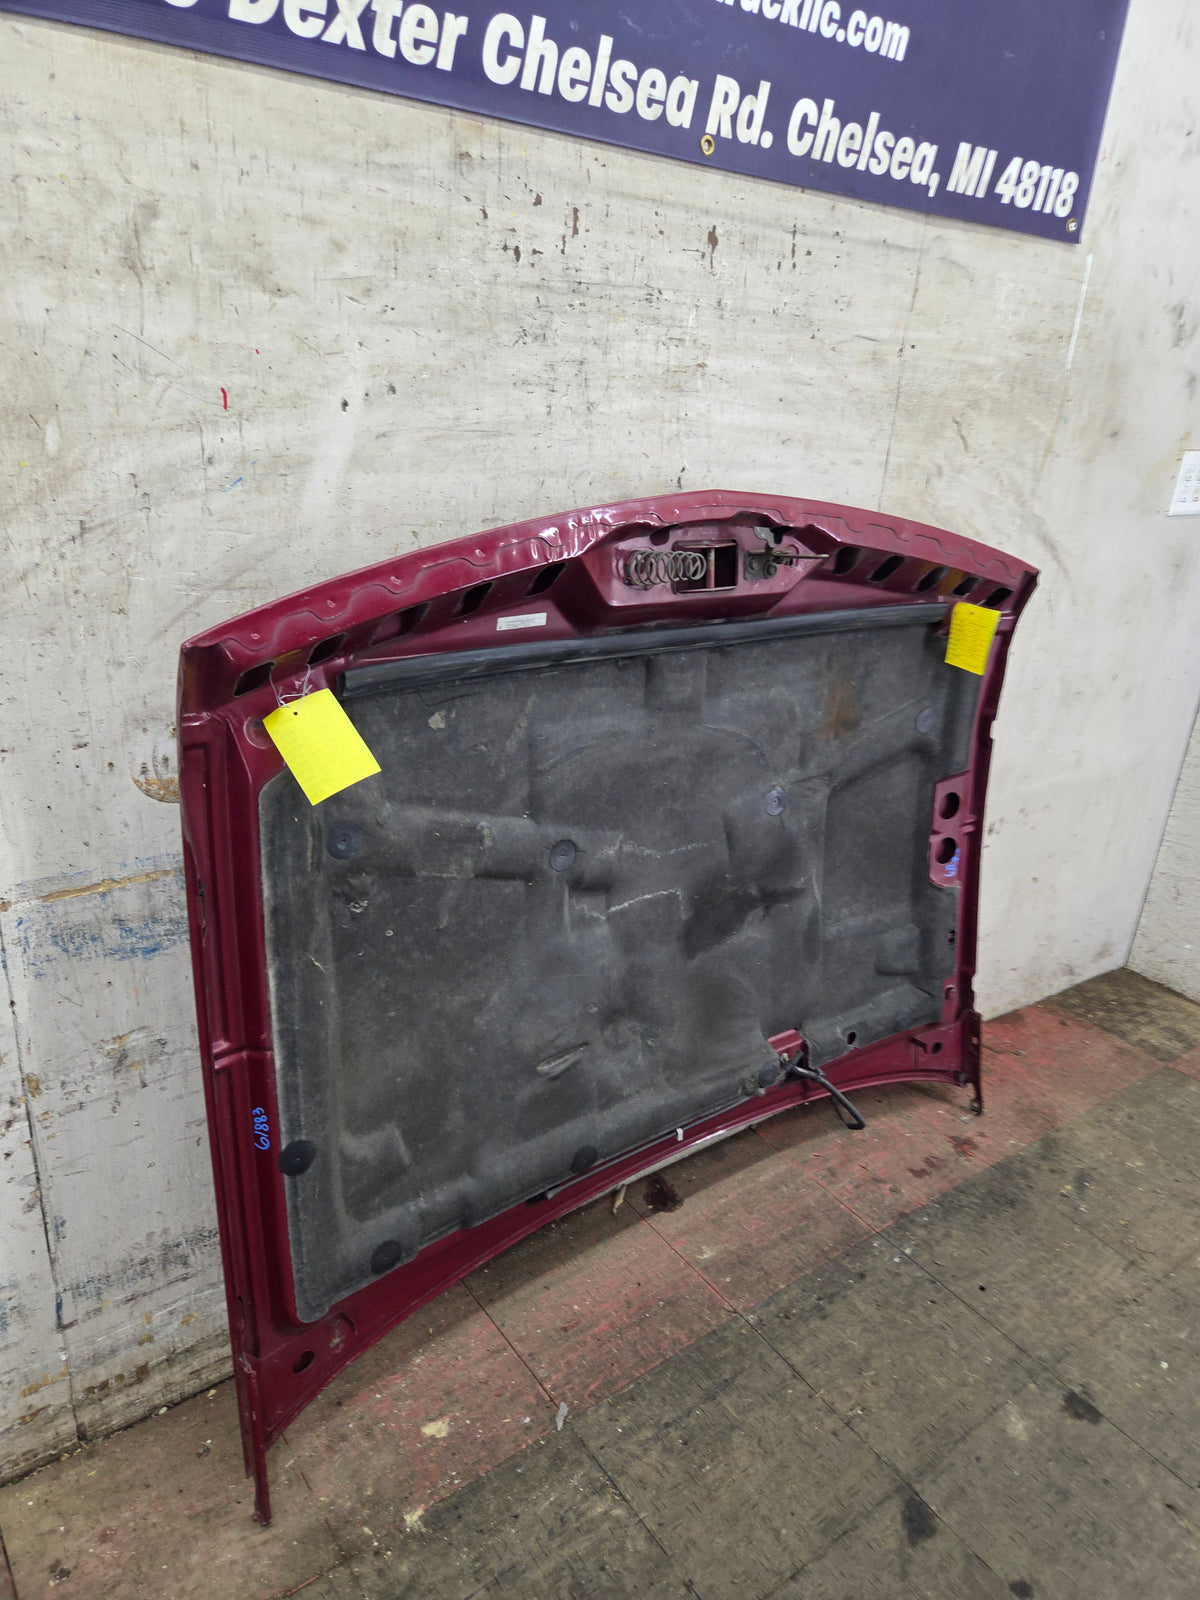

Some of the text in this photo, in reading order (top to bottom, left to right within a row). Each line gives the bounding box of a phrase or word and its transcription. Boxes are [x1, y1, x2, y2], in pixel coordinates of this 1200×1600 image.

[482, 12, 699, 129] Chelsea
[705, 74, 774, 149] Rd.
[787, 97, 940, 197] Chelsea,
[946, 141, 999, 198] MI
[994, 156, 1079, 218] 48118
[252, 1107, 270, 1150] 61883
